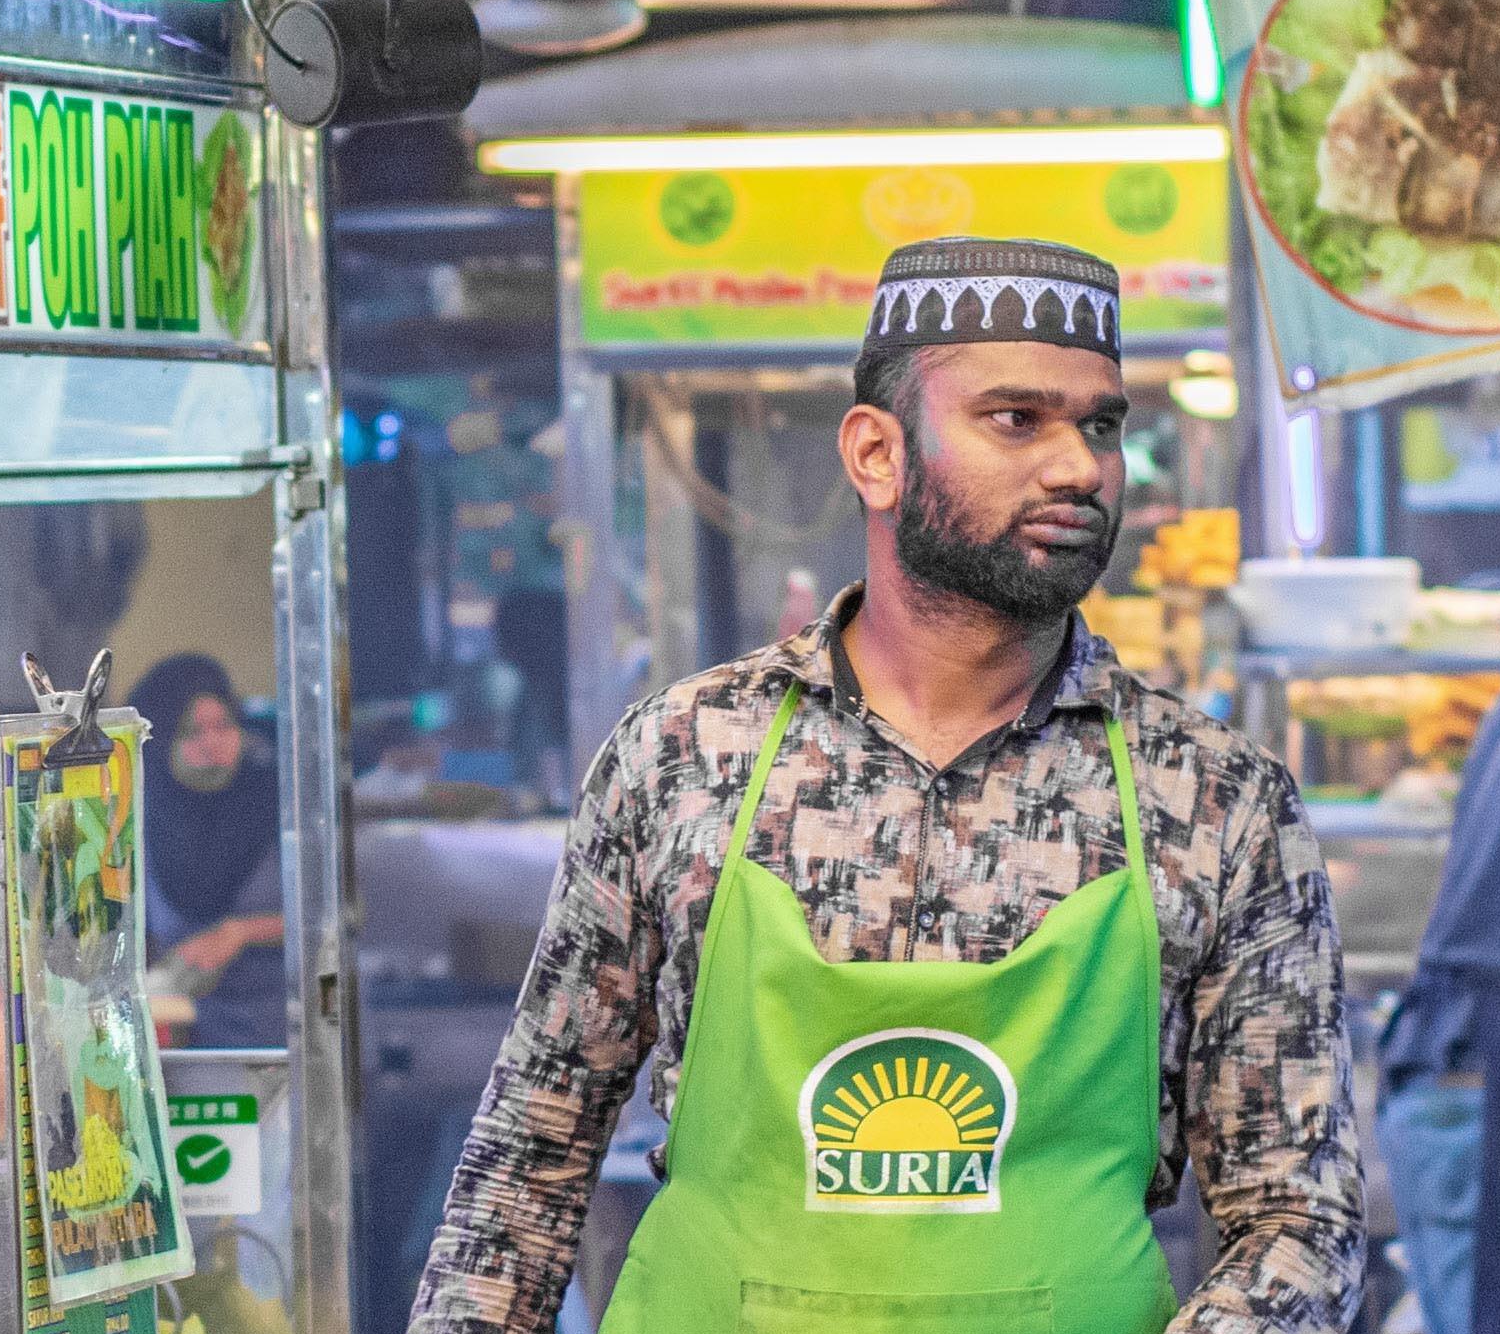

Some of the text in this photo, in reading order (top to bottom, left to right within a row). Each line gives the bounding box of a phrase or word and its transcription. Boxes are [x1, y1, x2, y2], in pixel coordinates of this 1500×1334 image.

[10, 90, 199, 332] POH PIAH
[815, 1149, 989, 1195] SURIA
